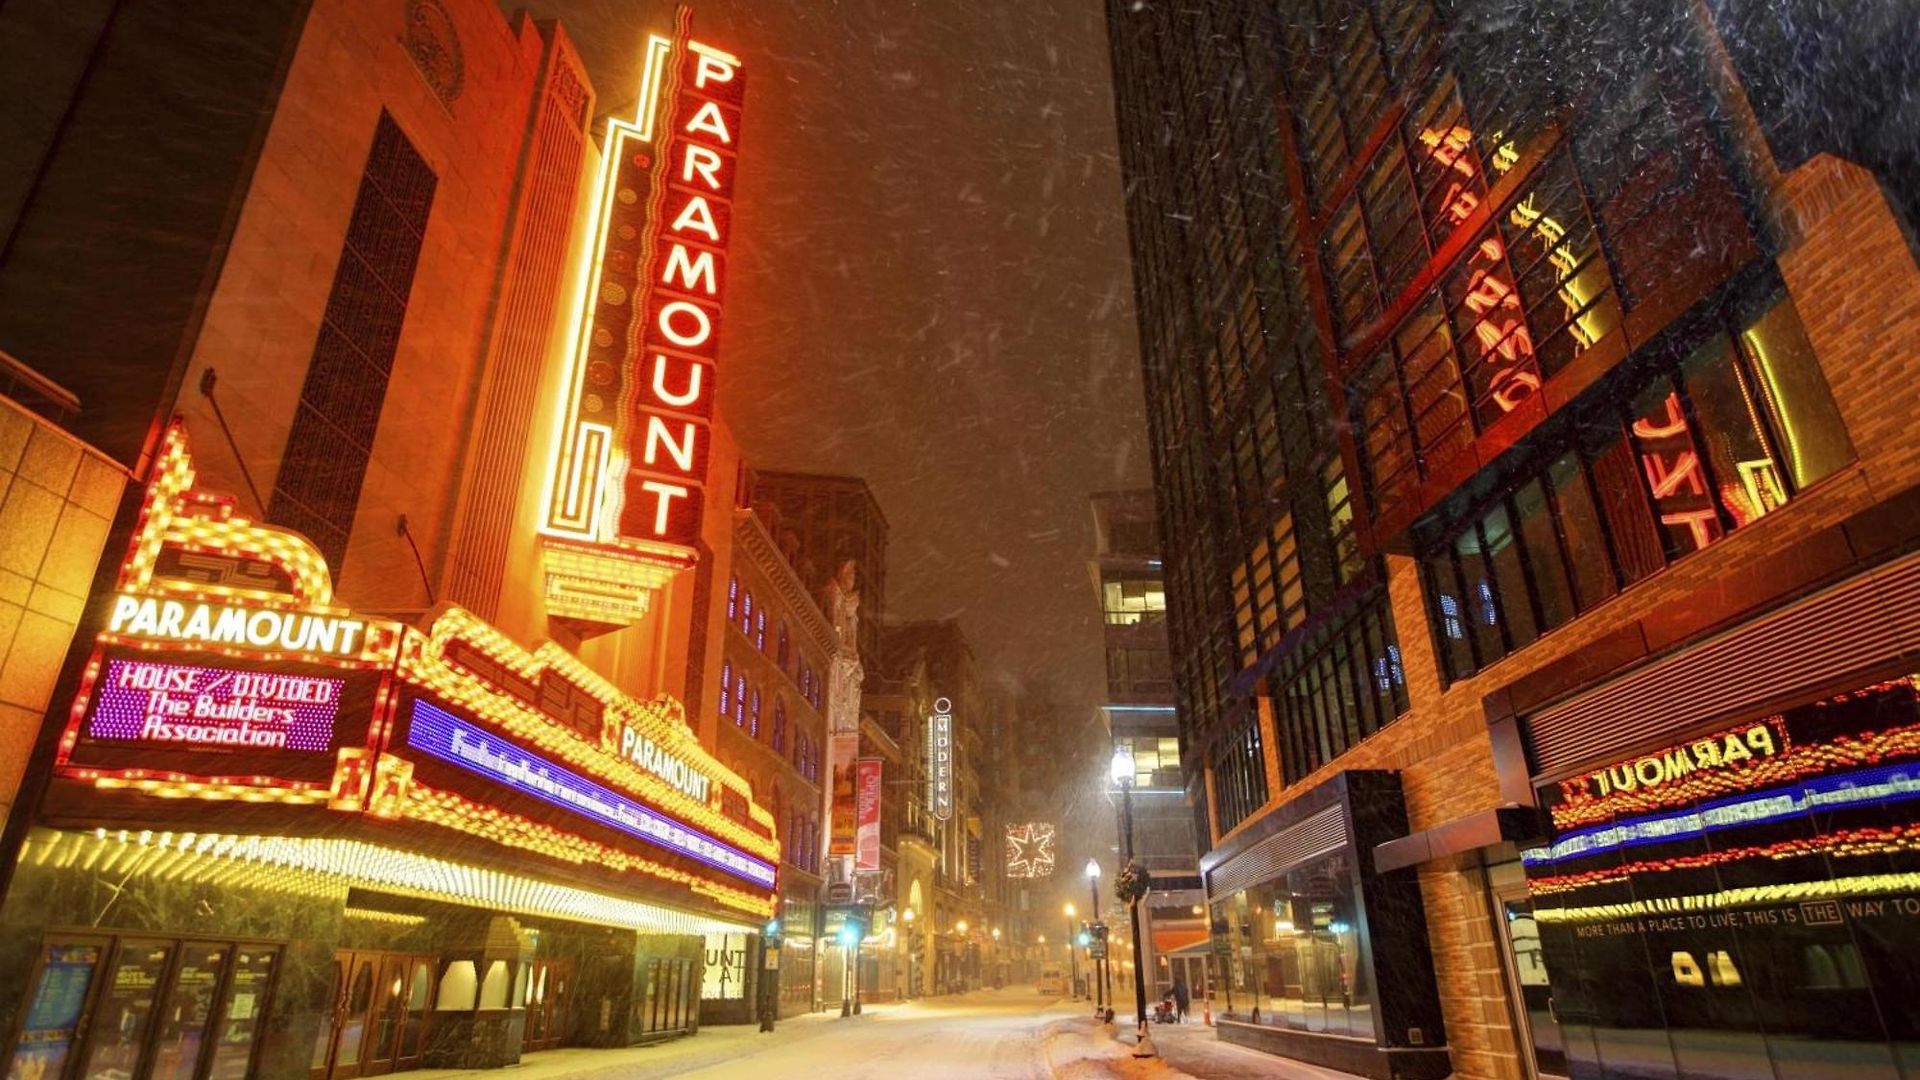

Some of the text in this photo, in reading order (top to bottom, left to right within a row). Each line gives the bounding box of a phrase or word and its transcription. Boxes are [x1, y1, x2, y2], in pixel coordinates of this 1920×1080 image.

[641, 53, 735, 537] PARAMOUNT
[109, 595, 363, 655] PARAMOUNT
[119, 665, 203, 693] HOUSE
[232, 673, 332, 704] DIVIDED
[147, 691, 295, 724] The Builders
[142, 715, 286, 748] Association
[621, 726, 711, 803] PARAMOUNT
[937, 718, 949, 807] MODERN
[1577, 925, 1605, 938] MORE
[1608, 922, 1635, 936] THAN
[1637, 921, 1647, 932] A
[1649, 917, 1686, 933] PLACE
[1688, 915, 1707, 929] TO
[1744, 909, 1778, 925] THIS
[1781, 907, 1797, 923] IS
[1804, 904, 1838, 920] THE
[1846, 900, 1885, 918] WAY
[1891, 898, 1920, 915] TO
